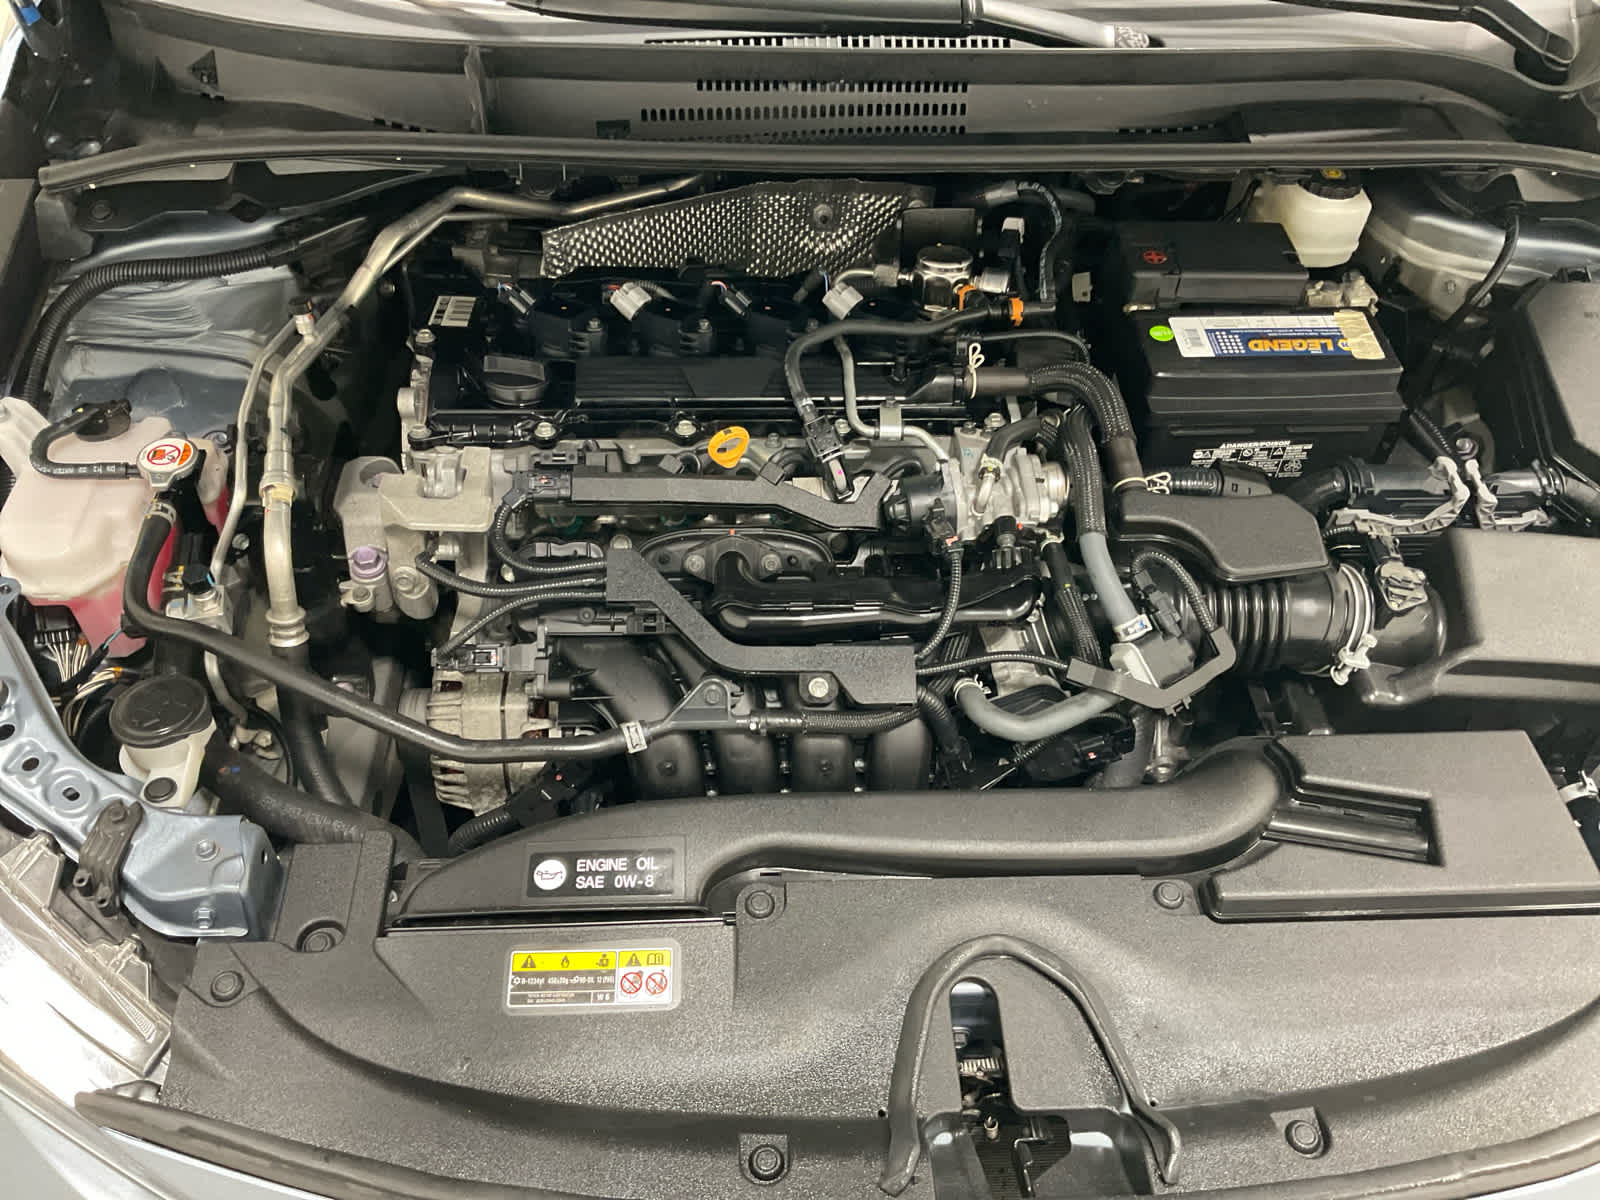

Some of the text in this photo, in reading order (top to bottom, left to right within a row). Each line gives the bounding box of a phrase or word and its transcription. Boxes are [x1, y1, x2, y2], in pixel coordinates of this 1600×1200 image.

[1247, 338, 1334, 351] LEGEND
[576, 857, 659, 872] ENGINE OIL
[575, 874, 655, 889] SAE 0W-8
